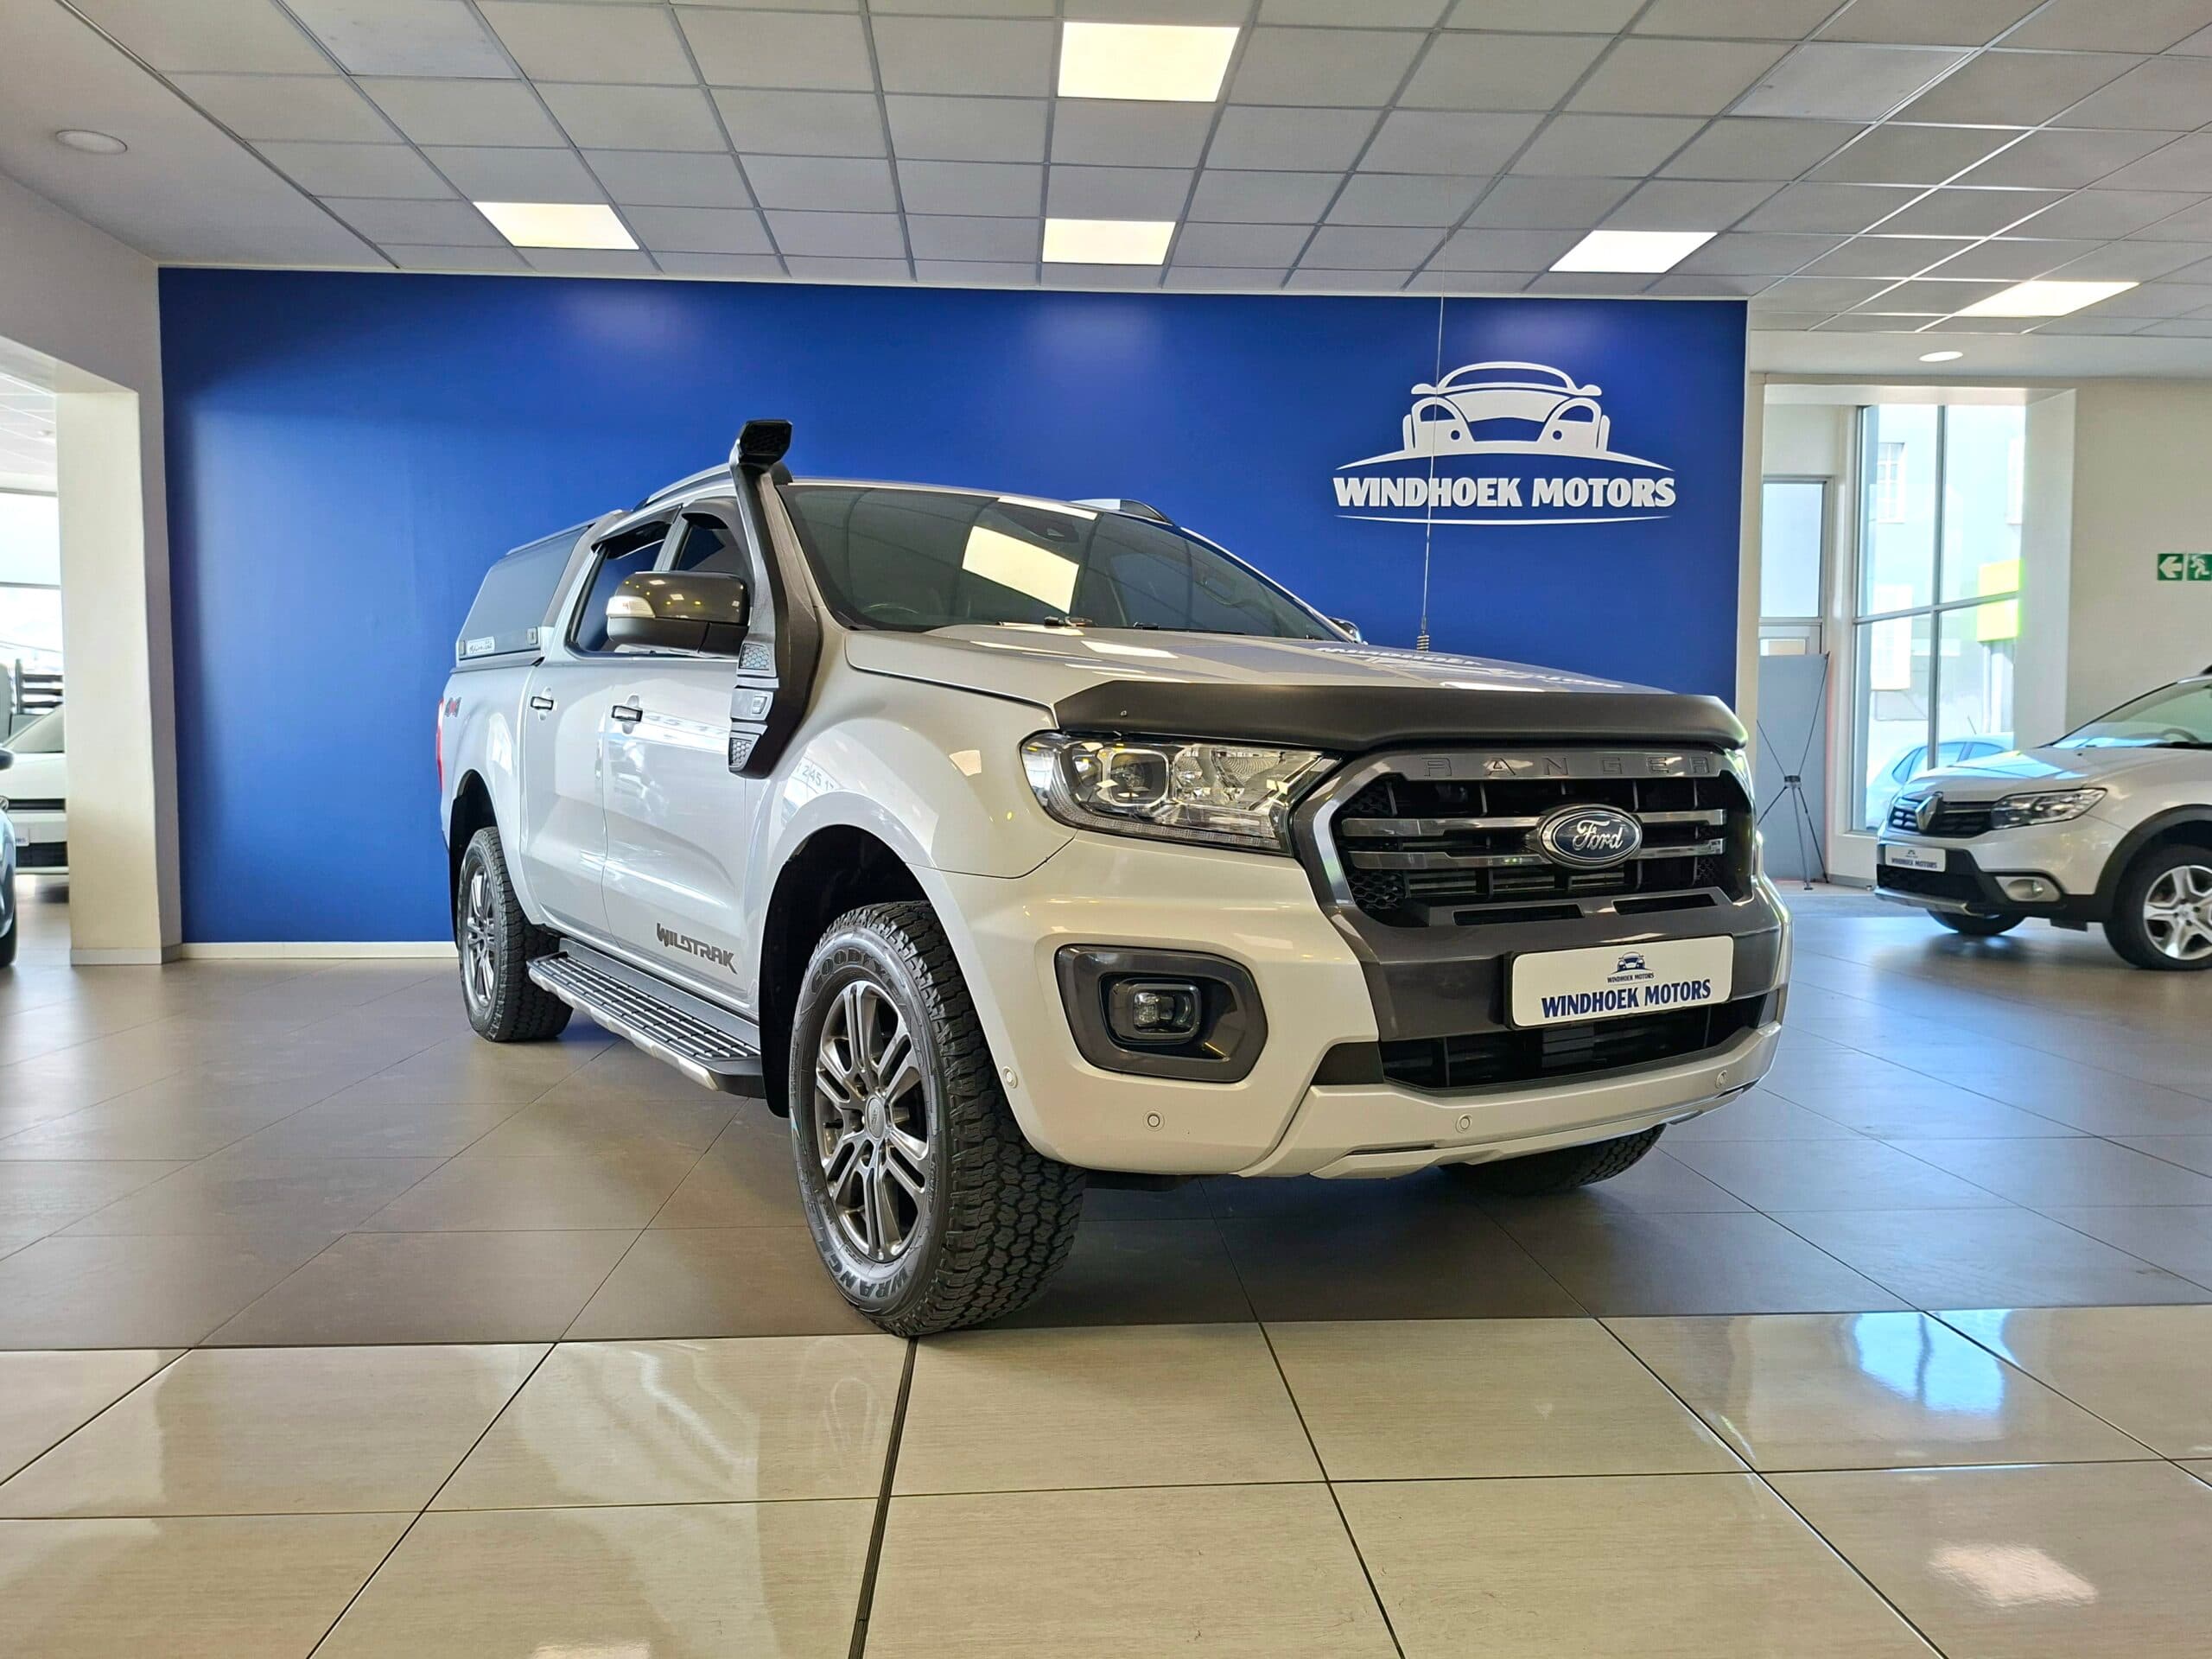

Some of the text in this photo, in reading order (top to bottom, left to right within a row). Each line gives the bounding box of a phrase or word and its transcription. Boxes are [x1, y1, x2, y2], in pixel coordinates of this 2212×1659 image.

[1332, 477, 1677, 508] WINDHOEK MOTORS
[1421, 756, 1710, 777] RANGER
[1573, 819, 1624, 851] Ford
[657, 922, 738, 975] WILDTRAK
[1607, 975, 1633, 983] WINDHOEK
[1541, 978, 1712, 1019] WINDHOEK MOTORS
